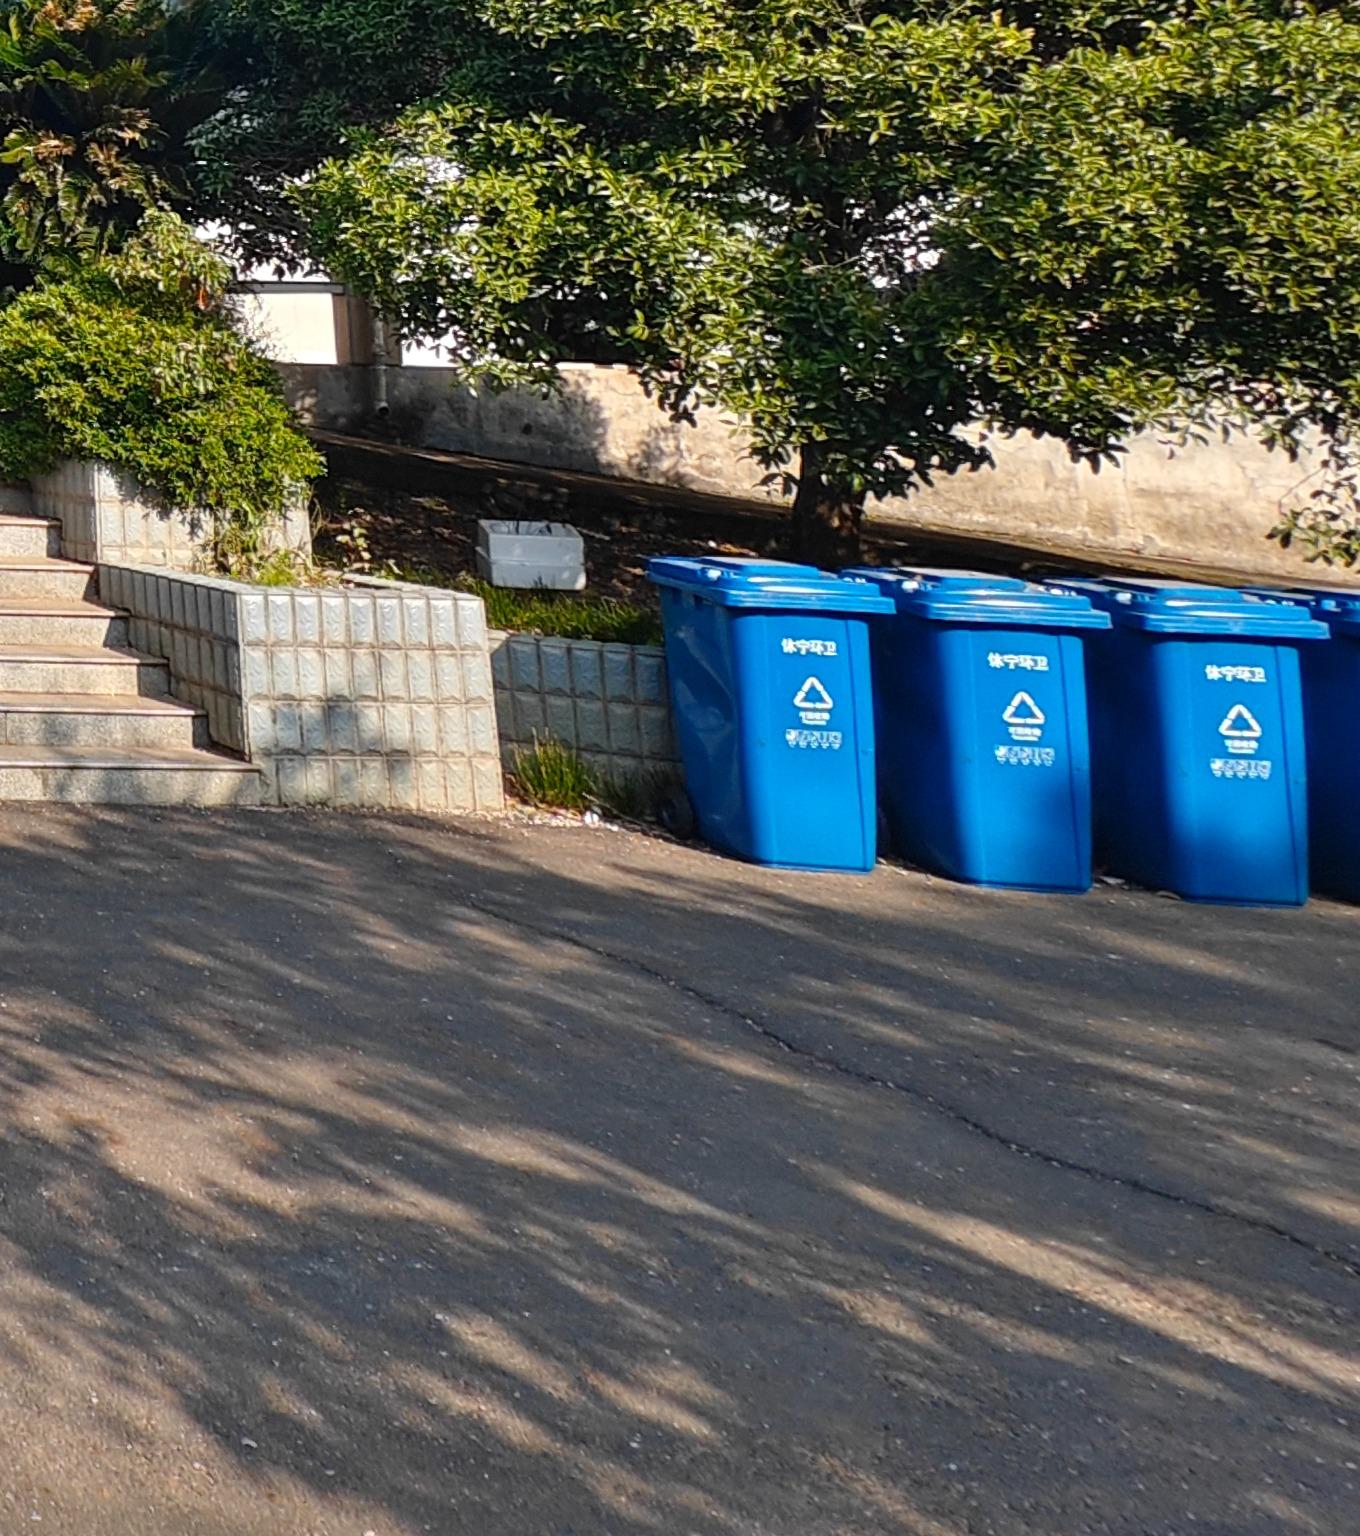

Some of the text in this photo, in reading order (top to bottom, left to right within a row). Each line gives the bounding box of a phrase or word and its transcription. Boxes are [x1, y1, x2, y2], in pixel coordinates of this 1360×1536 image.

[781, 638, 838, 655] 休宁环卫
[987, 652, 1049, 670] 休宁环卫
[1205, 664, 1267, 682] 休宁环卫
